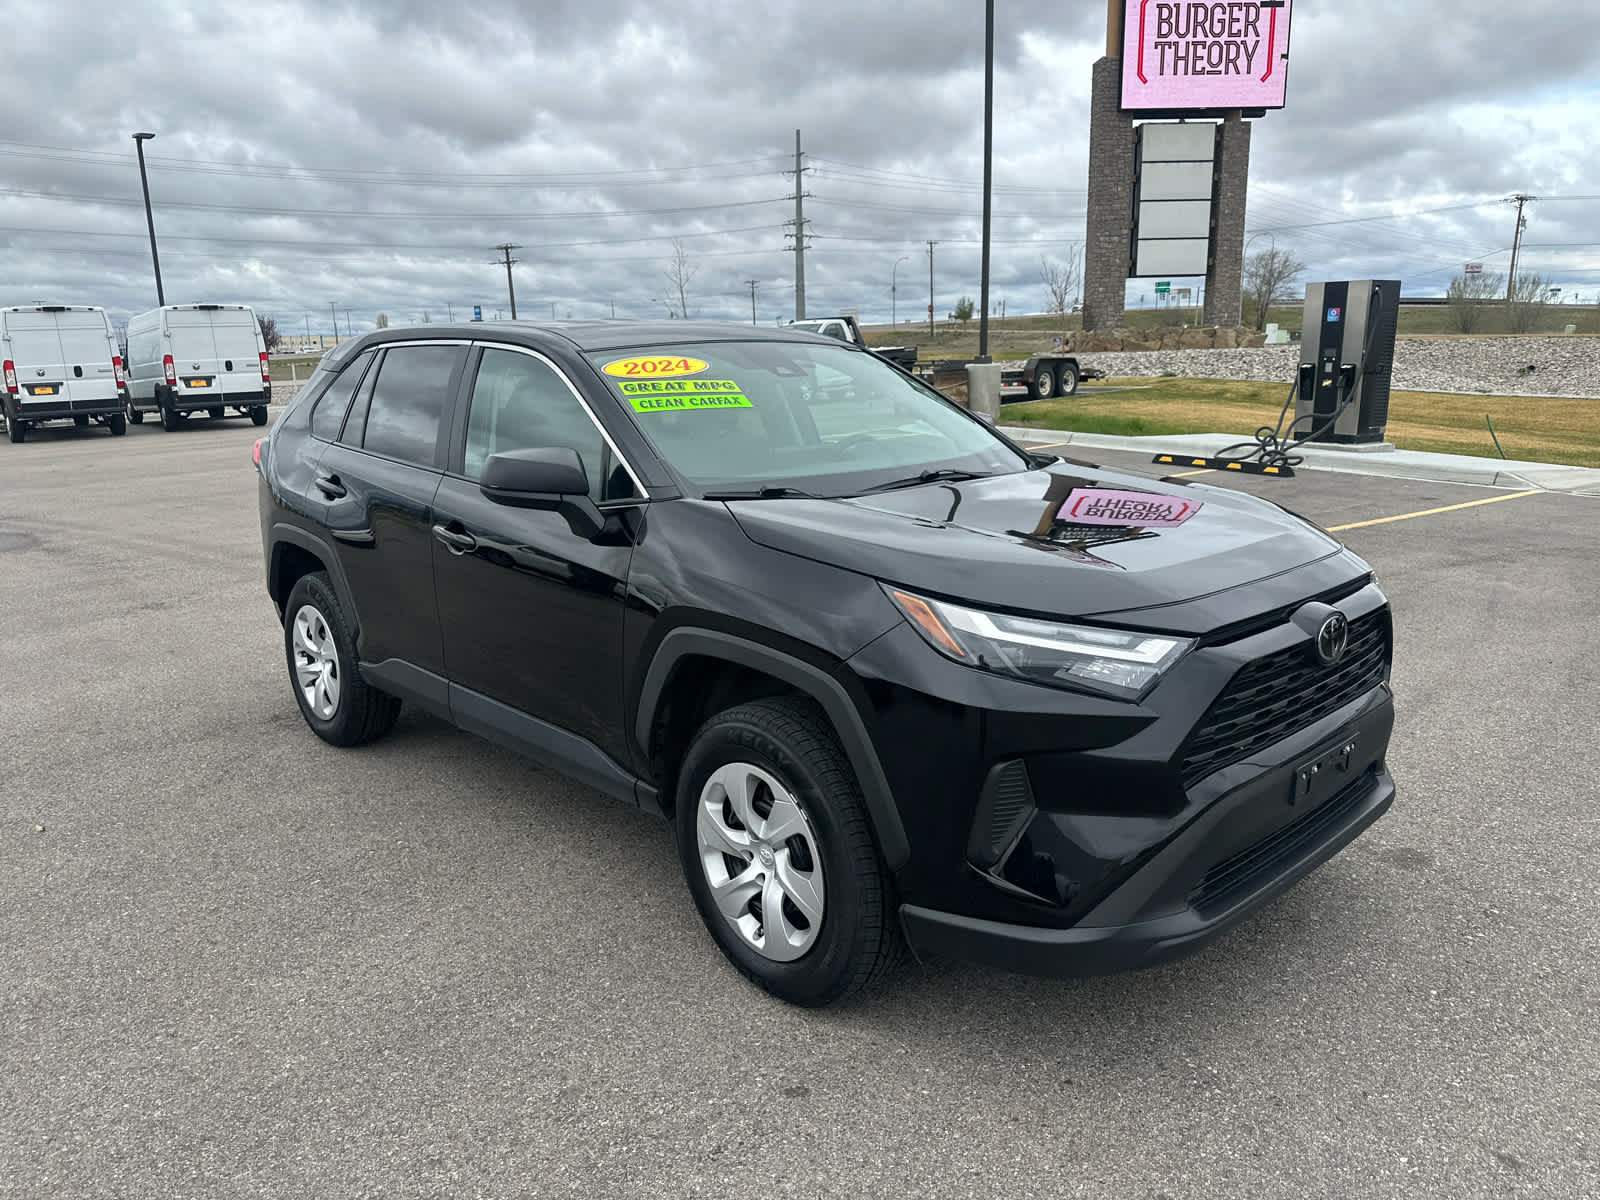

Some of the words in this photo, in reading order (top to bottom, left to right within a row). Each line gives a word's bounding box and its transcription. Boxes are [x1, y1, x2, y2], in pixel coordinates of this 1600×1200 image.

[1156, 2, 1261, 39] BURGER
[1154, 39, 1261, 76] THEORY
[623, 359, 692, 375] 2024
[623, 381, 687, 393] GREAT
[692, 381, 736, 392] MPG
[639, 398, 685, 409] CLEAN
[688, 396, 742, 408] CARFAX
